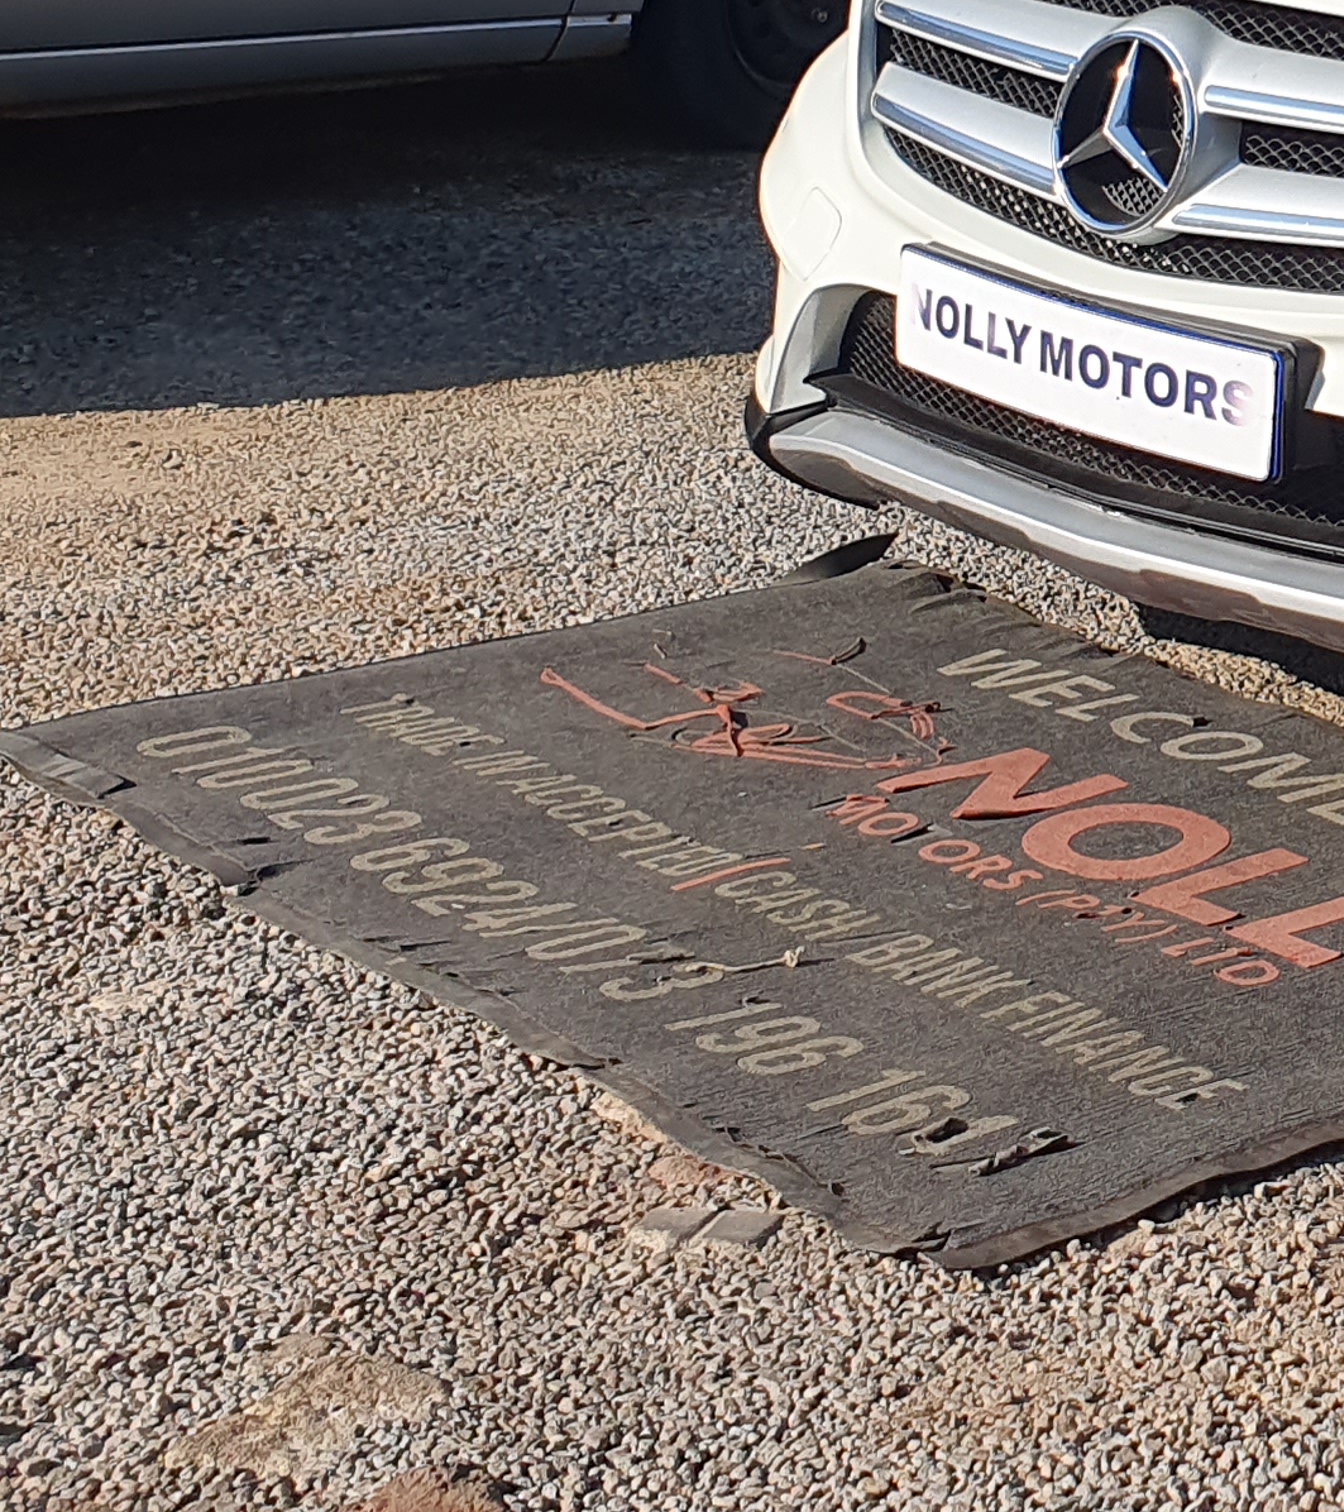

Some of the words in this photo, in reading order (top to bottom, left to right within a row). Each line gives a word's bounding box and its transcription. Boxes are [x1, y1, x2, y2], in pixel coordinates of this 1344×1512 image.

[914, 282, 1032, 366] NOLLY
[1040, 330, 1256, 427] MOTORS
[340, 692, 506, 756] TRADE
[452, 749, 551, 777] IN
[981, 990, 1247, 1110] FINANCE
[825, 793, 1043, 890] MOORS
